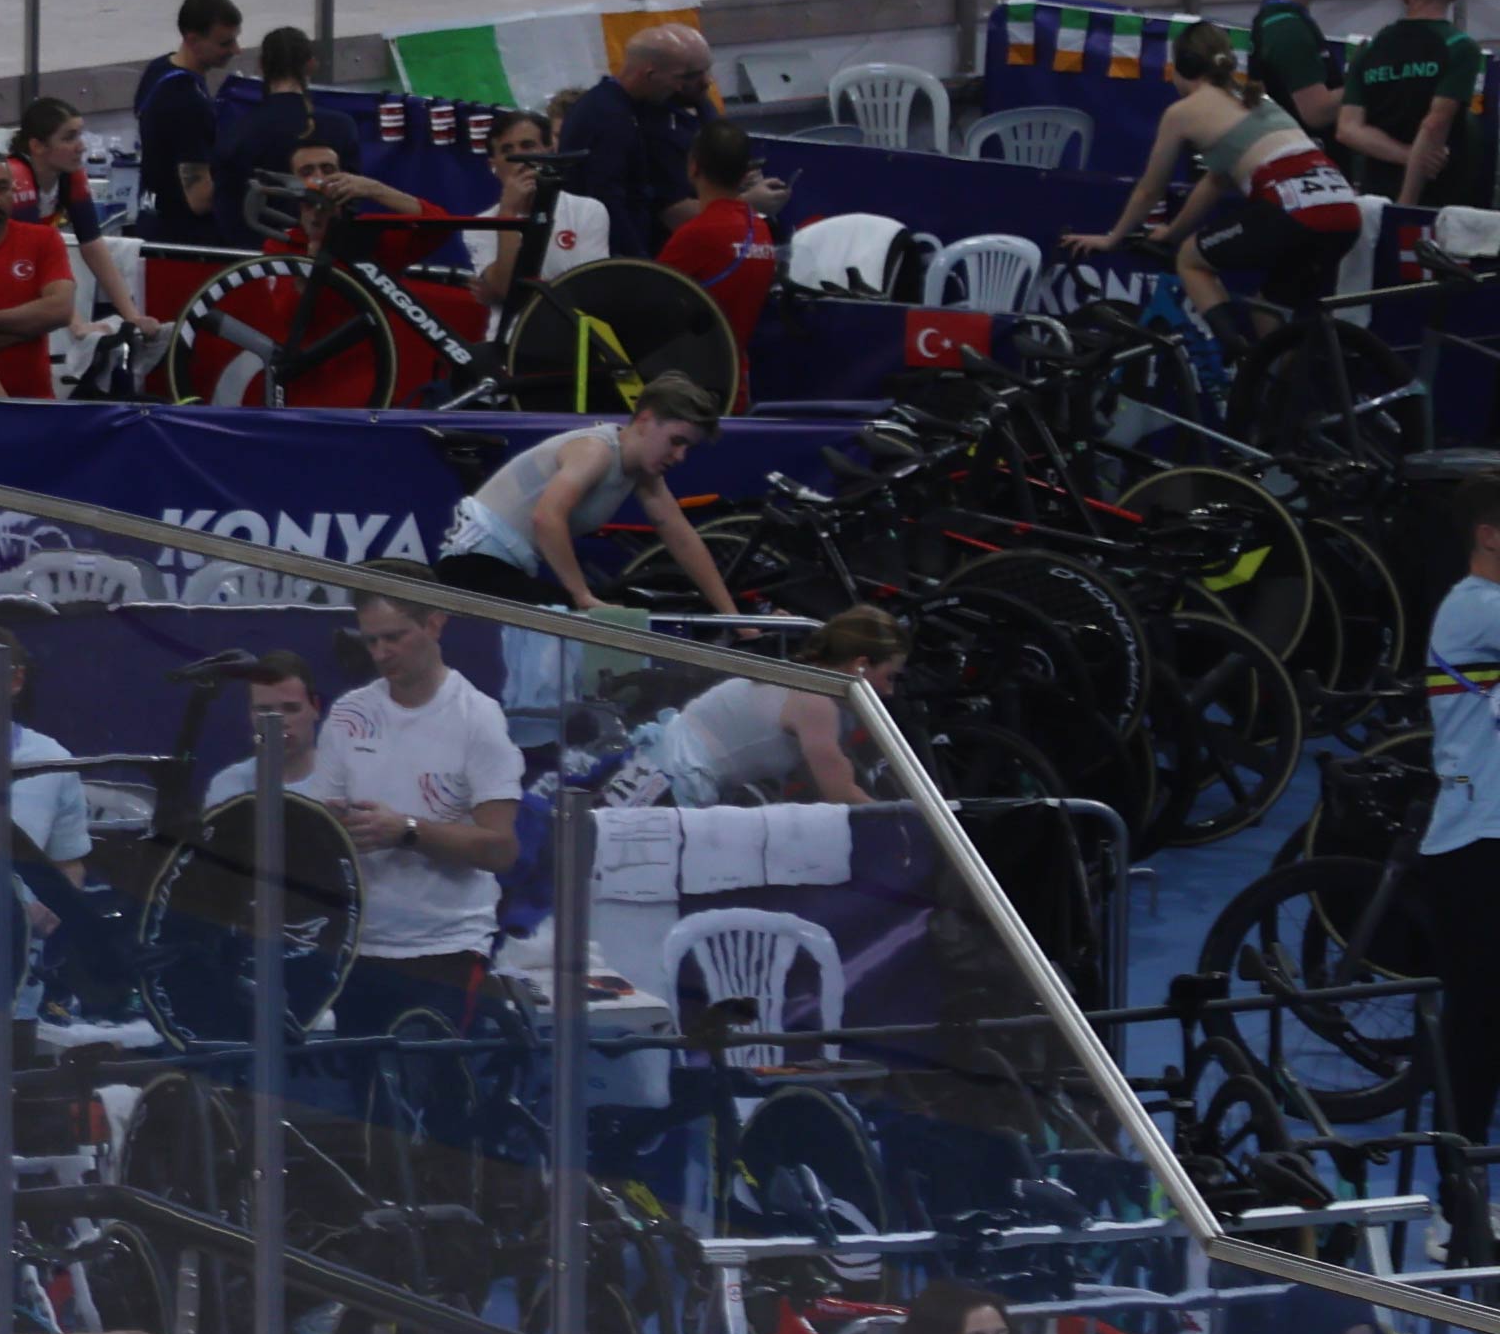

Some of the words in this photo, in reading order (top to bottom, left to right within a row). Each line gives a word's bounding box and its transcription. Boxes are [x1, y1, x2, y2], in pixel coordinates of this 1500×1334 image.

[353, 261, 448, 342] ARGON
[443, 337, 473, 365] 18
[156, 508, 431, 570] KONYA
